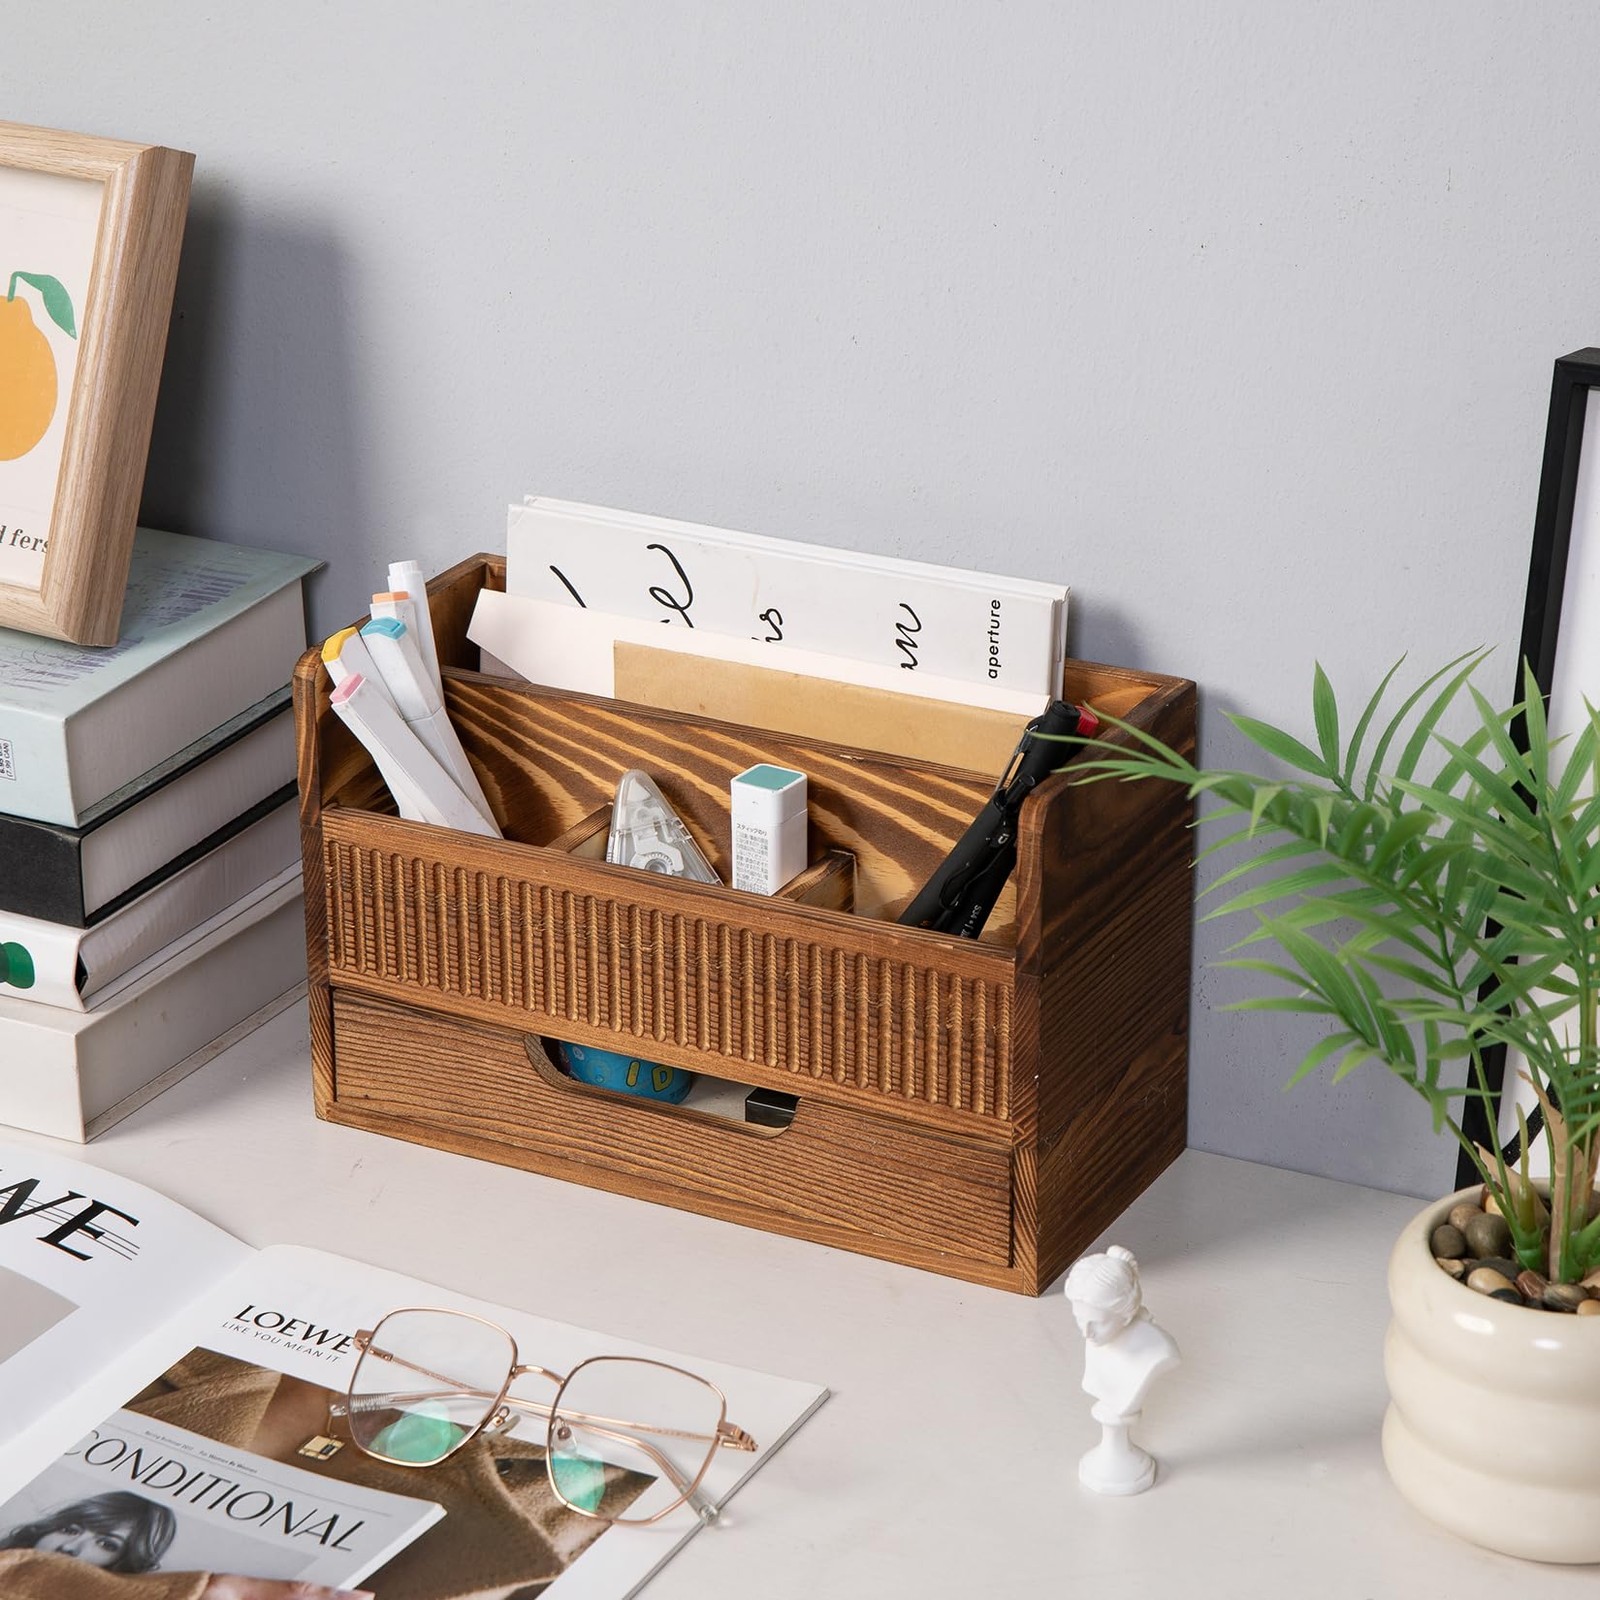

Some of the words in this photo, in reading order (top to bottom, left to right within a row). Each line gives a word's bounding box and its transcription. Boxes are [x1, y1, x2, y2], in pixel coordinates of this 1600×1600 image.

[987, 599, 1002, 679] aperture
[221, 1321, 251, 1335] LIKE
[254, 1331, 282, 1345] YOU
[283, 1341, 324, 1358] MEAN
[325, 1354, 341, 1364] IT
[233, 1304, 356, 1354] LOEWE
